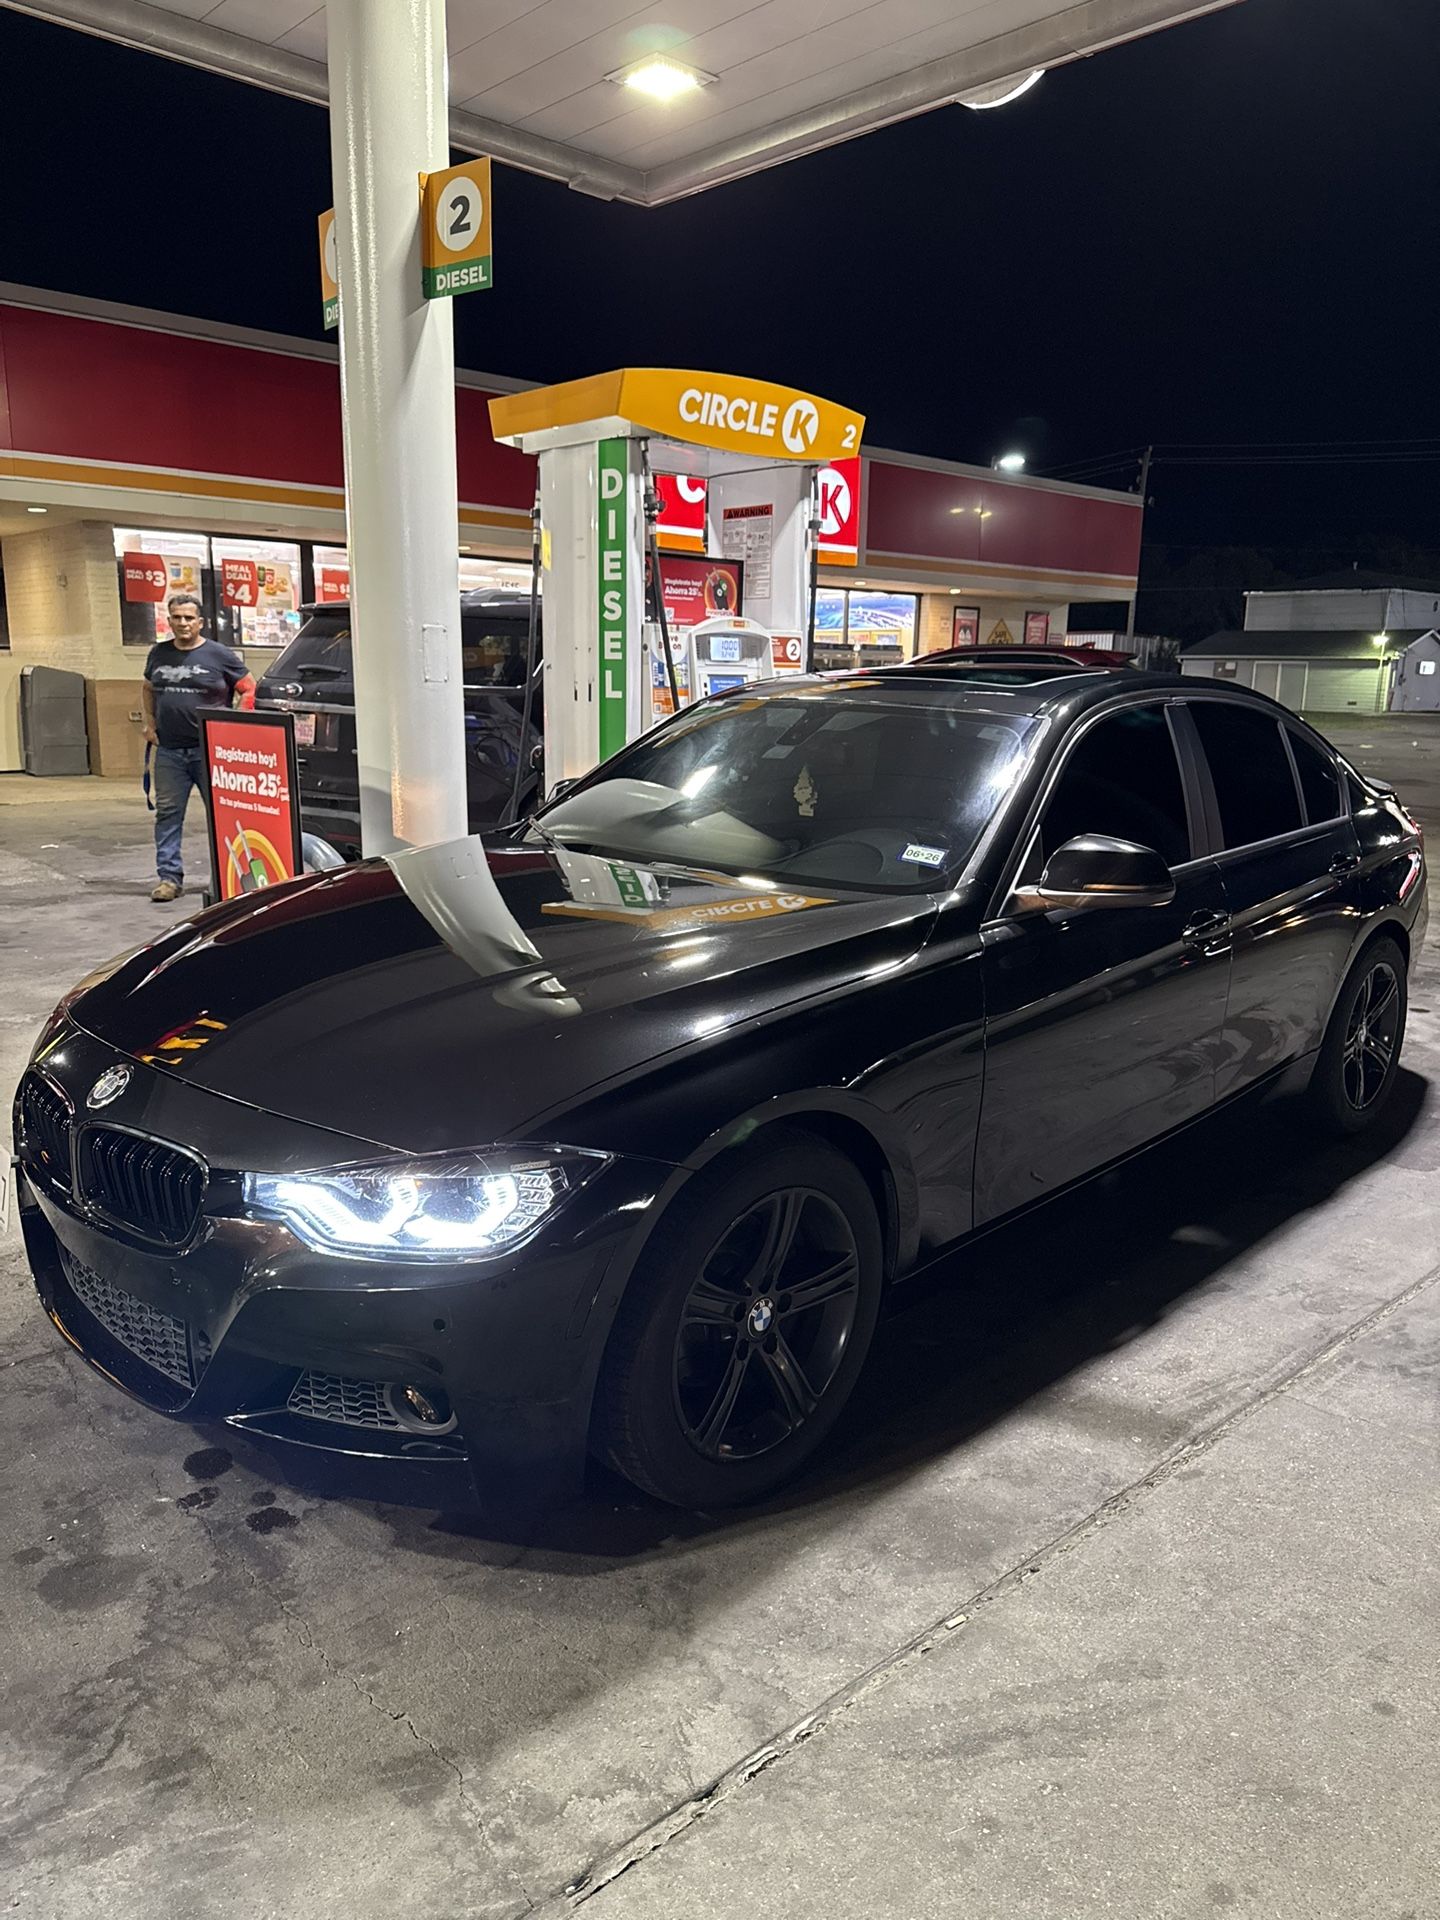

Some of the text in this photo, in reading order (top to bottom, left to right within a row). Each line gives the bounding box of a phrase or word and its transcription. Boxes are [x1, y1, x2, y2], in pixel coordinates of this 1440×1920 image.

[449, 195, 471, 235] 2
[436, 265, 487, 291] DIESEL
[679, 388, 857, 453] CIRCLE K 2
[733, 506, 769, 518] WARNING
[145, 569, 166, 587] $3
[225, 564, 251, 574] MEAL
[601, 468, 623, 699] DIESEL
[665, 586, 688, 596] Ahorra
[226, 583, 252, 604] $4
[790, 643, 798, 656] 2
[258, 751, 277, 769] hoy!
[212, 765, 257, 795] Ahorra
